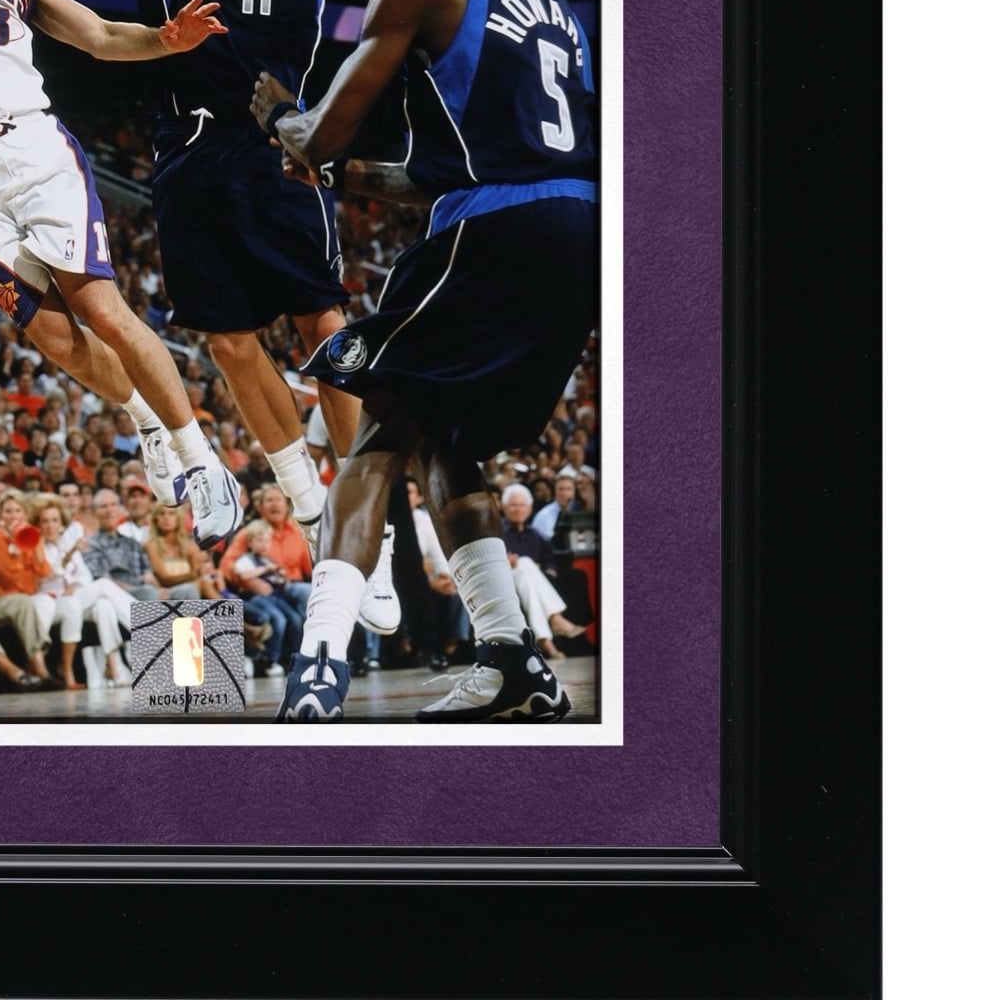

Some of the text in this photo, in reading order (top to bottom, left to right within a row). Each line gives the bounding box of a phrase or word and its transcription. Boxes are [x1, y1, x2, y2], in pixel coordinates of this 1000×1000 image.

[537, 38, 575, 152] 5
[320, 161, 335, 188] 5
[93, 221, 112, 264] 1
